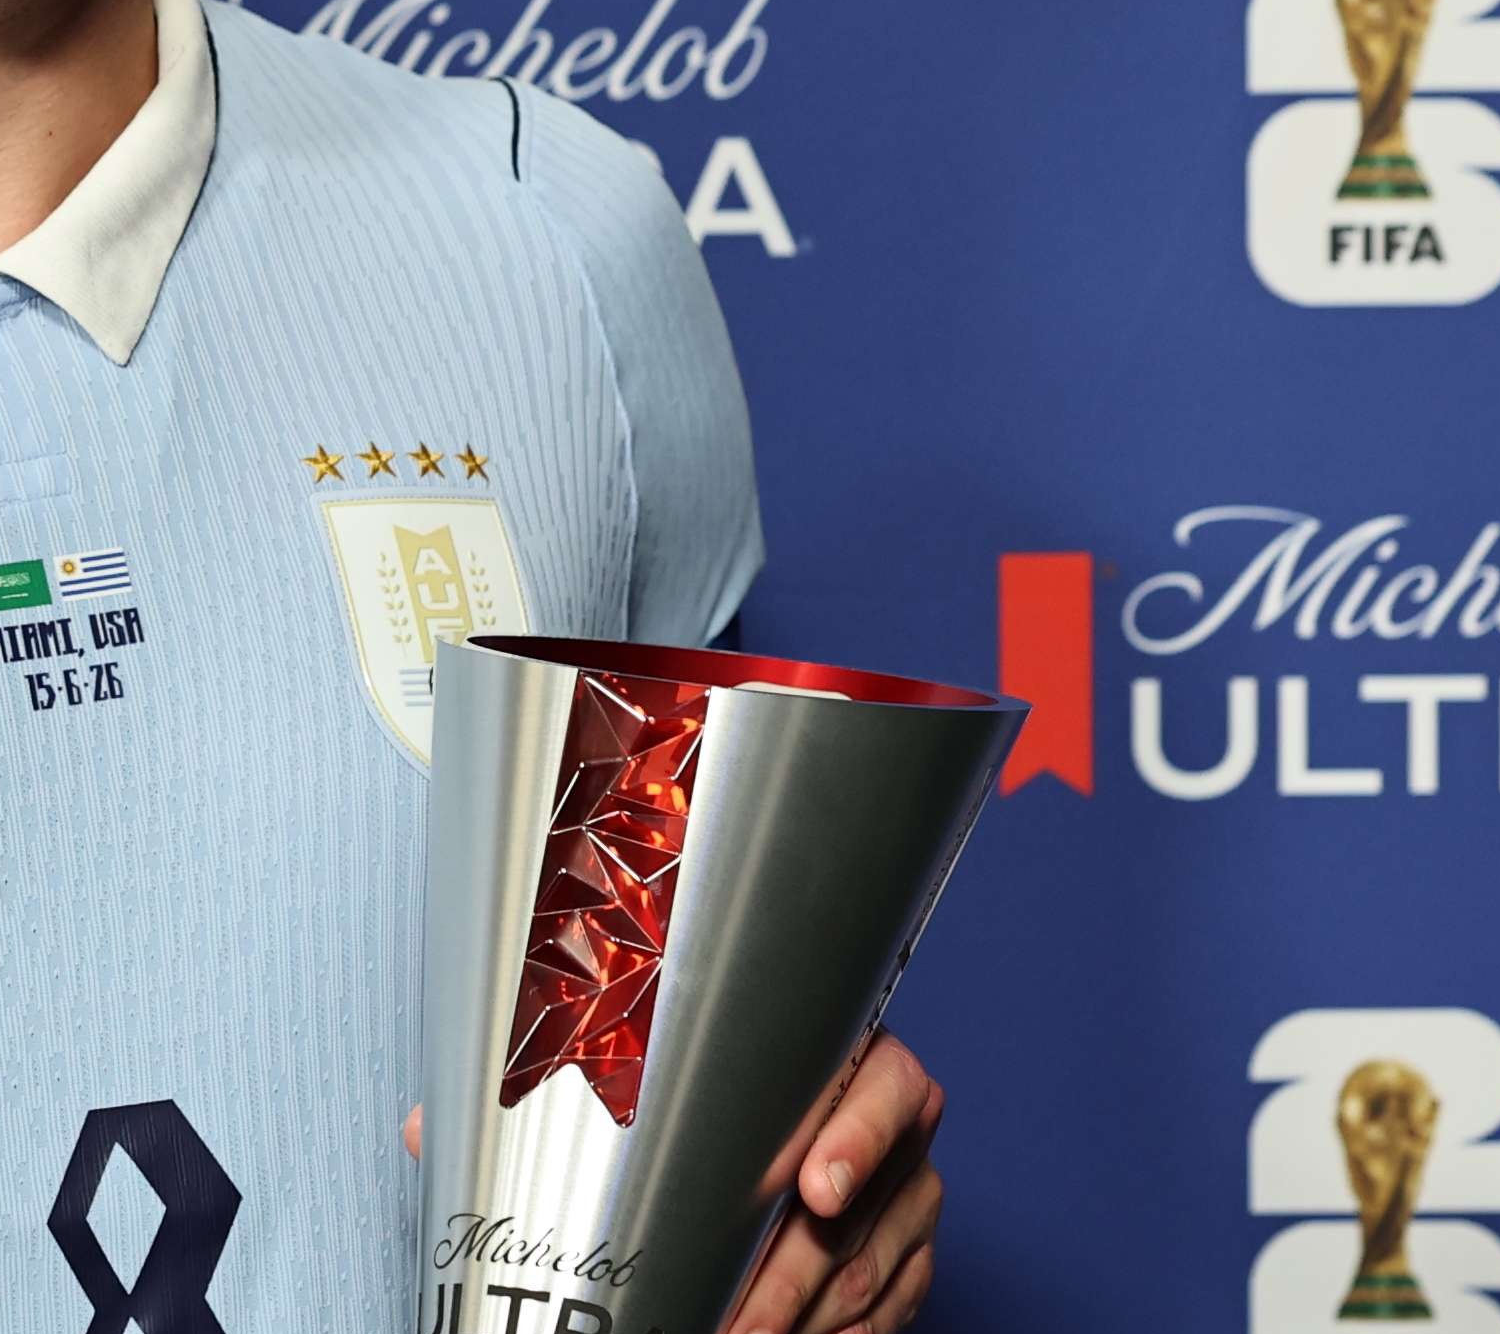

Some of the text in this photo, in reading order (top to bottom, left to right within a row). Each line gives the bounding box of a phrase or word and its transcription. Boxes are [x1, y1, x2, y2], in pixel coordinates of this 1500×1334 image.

[1327, 223, 1445, 265] FIFA
[88, 606, 145, 651] USA
[433, 1211, 645, 1288] Michelob
